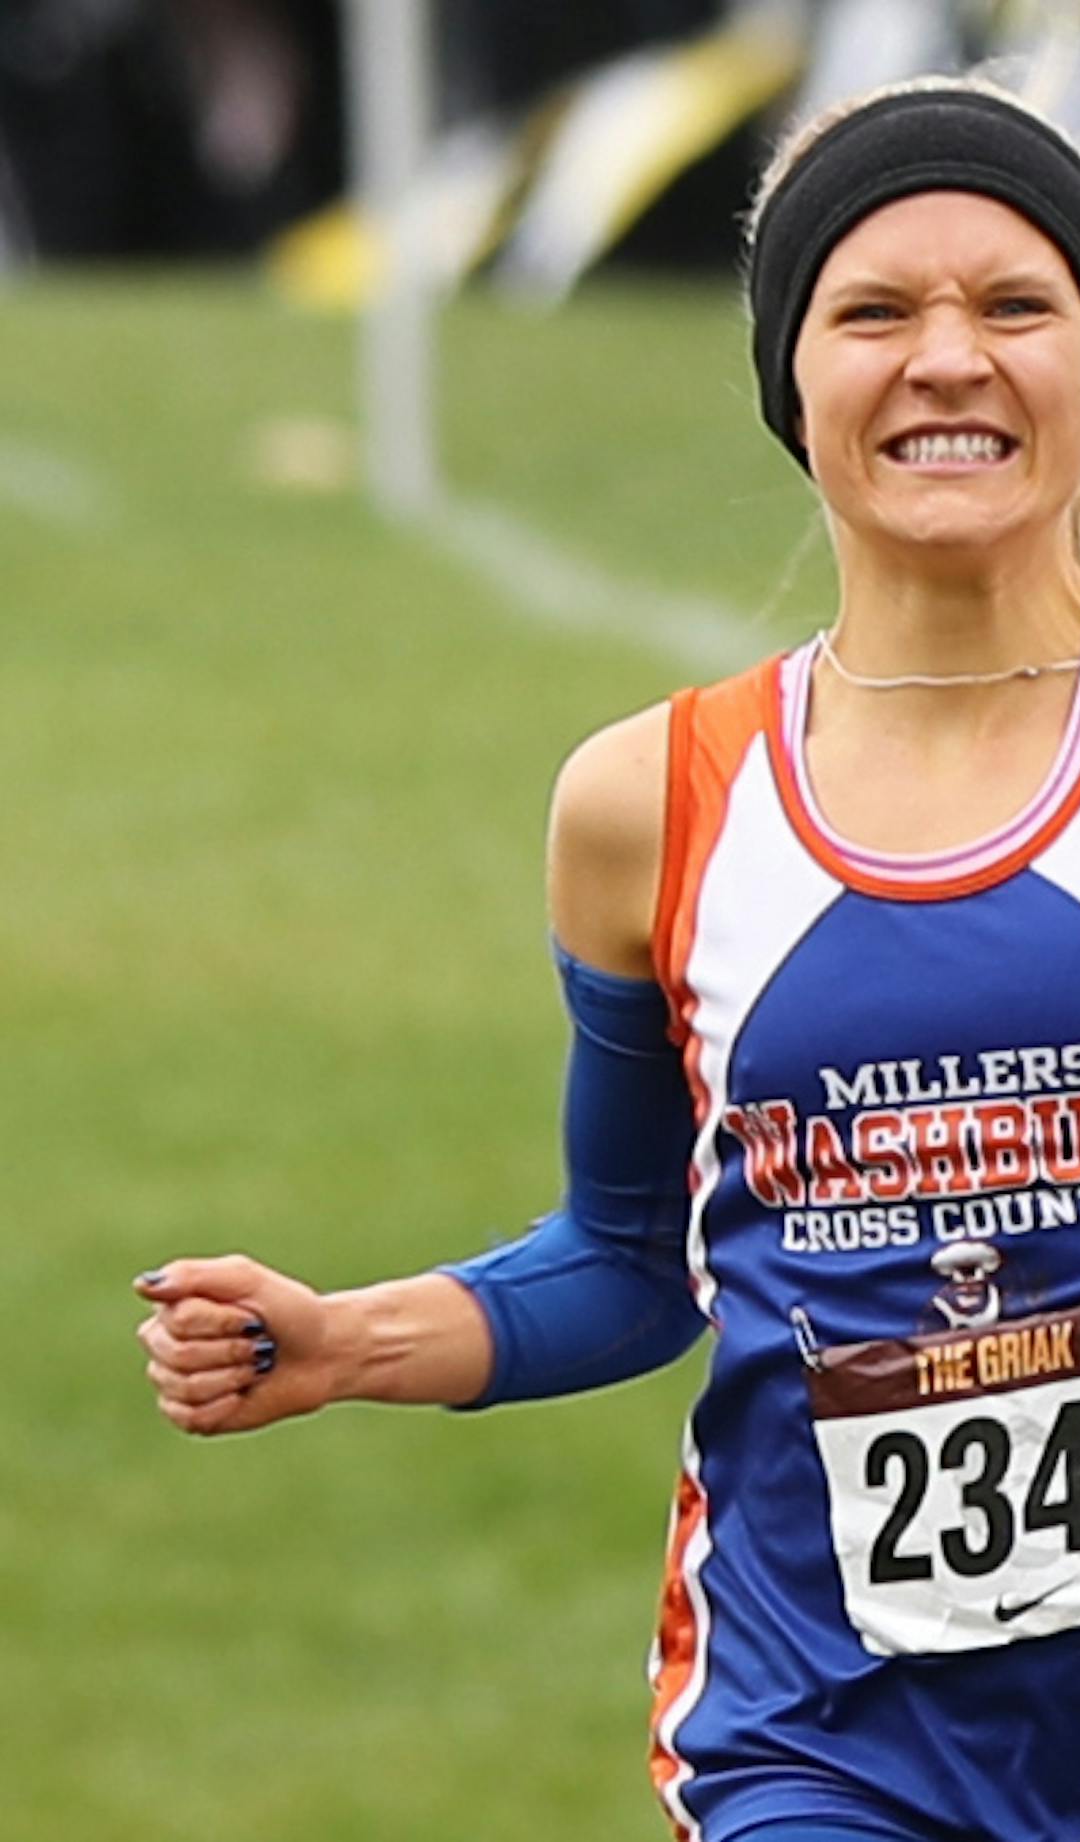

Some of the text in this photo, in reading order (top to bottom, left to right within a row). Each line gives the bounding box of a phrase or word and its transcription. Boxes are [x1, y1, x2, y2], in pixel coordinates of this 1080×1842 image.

[781, 1207, 921, 1254] CROSS
[916, 1321, 1075, 1396] THE GRIAK
